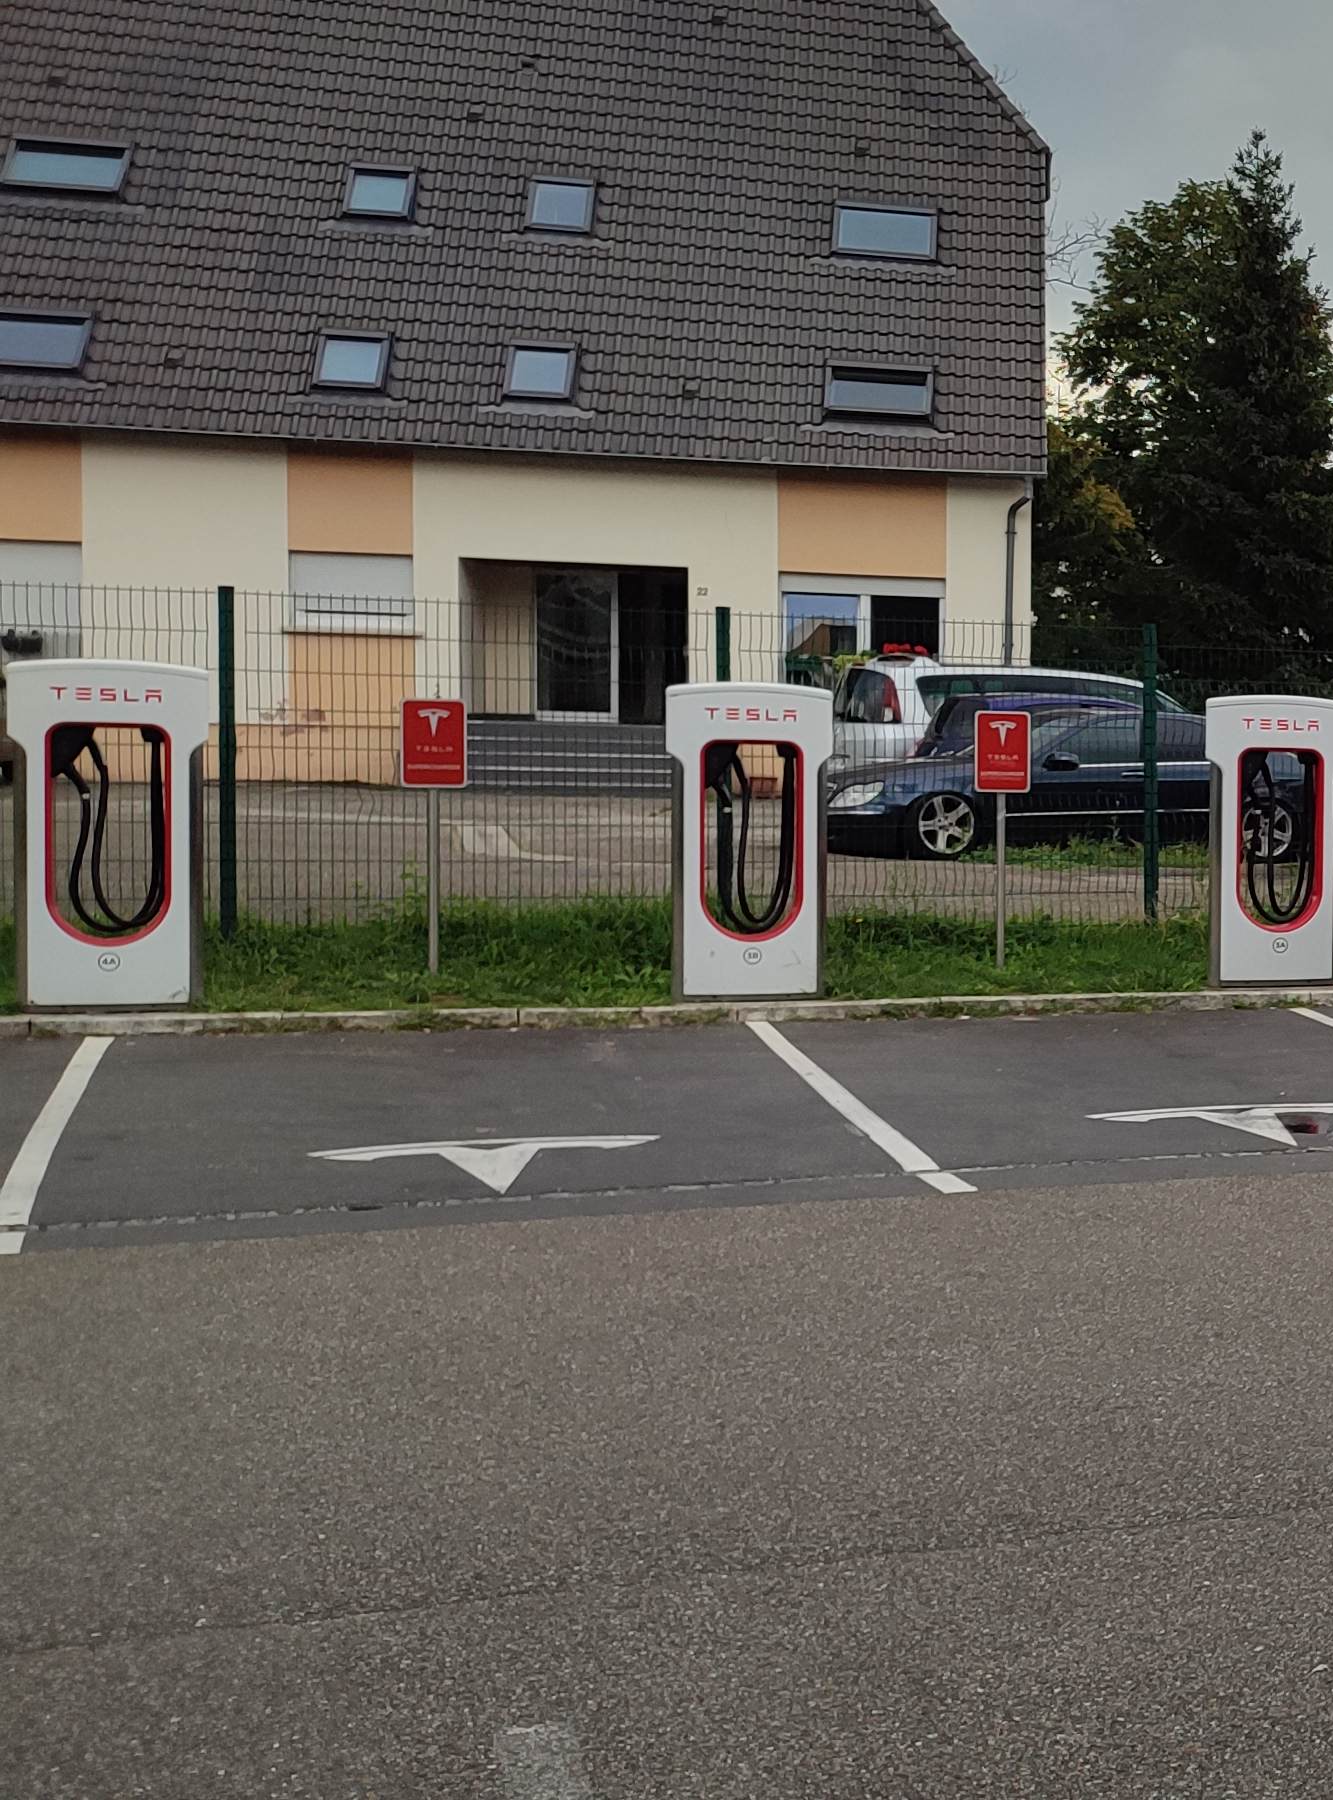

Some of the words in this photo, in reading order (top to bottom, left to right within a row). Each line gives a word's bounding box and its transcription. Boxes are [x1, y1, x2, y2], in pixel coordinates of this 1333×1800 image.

[49, 686, 162, 703] TESLA
[704, 707, 797, 722] TESLA
[1242, 718, 1319, 731] TESLA
